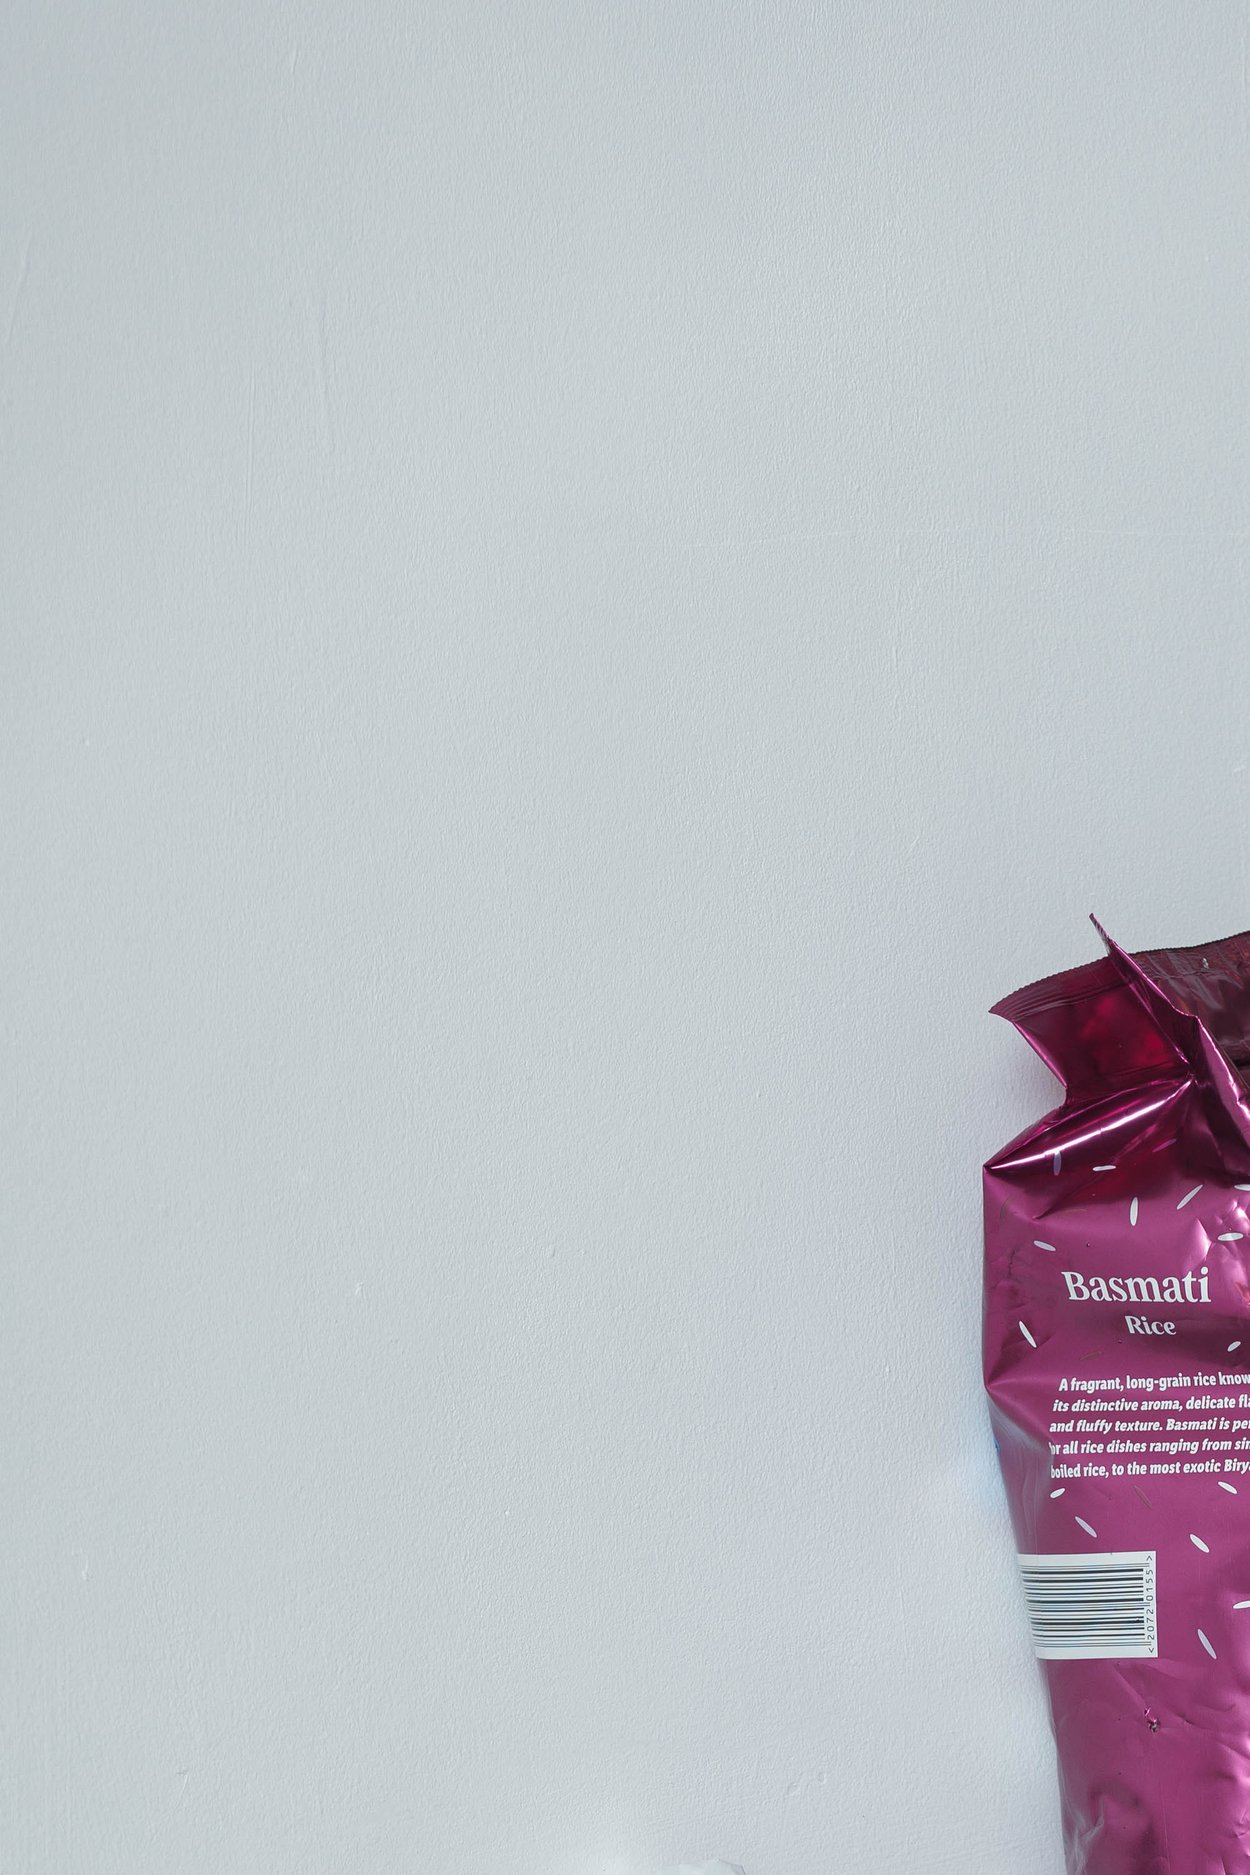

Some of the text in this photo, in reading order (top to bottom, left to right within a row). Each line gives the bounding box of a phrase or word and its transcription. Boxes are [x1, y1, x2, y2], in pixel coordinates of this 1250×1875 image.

[1061, 1266, 1212, 1304] Basmati
[1124, 1315, 1177, 1336] Rice
[1058, 1378, 1068, 1392] A
[1070, 1376, 1124, 1394] fragrant,
[1126, 1372, 1191, 1392] long-grain
[1193, 1371, 1217, 1387] rice
[1052, 1399, 1069, 1412] its
[1071, 1397, 1139, 1412] distinctive
[1140, 1399, 1183, 1412] aroma,
[1185, 1395, 1236, 1410] delicate
[1049, 1419, 1074, 1433] and
[1076, 1419, 1112, 1434] fluffy
[1114, 1419, 1163, 1432] texture.
[1166, 1417, 1218, 1431] Basmati
[1219, 1416, 1230, 1430] is
[1062, 1440, 1078, 1455] all
[1080, 1440, 1104, 1454] rice
[1106, 1439, 1147, 1454] dishes
[1149, 1438, 1199, 1454] ranging
[1202, 1437, 1232, 1451] from
[1050, 1463, 1081, 1479] boiled
[1083, 1462, 1110, 1478] rice,
[1111, 1462, 1125, 1476] to
[1126, 1460, 1147, 1475] the
[1149, 1460, 1181, 1475] most
[1183, 1458, 1221, 1474] exotic
